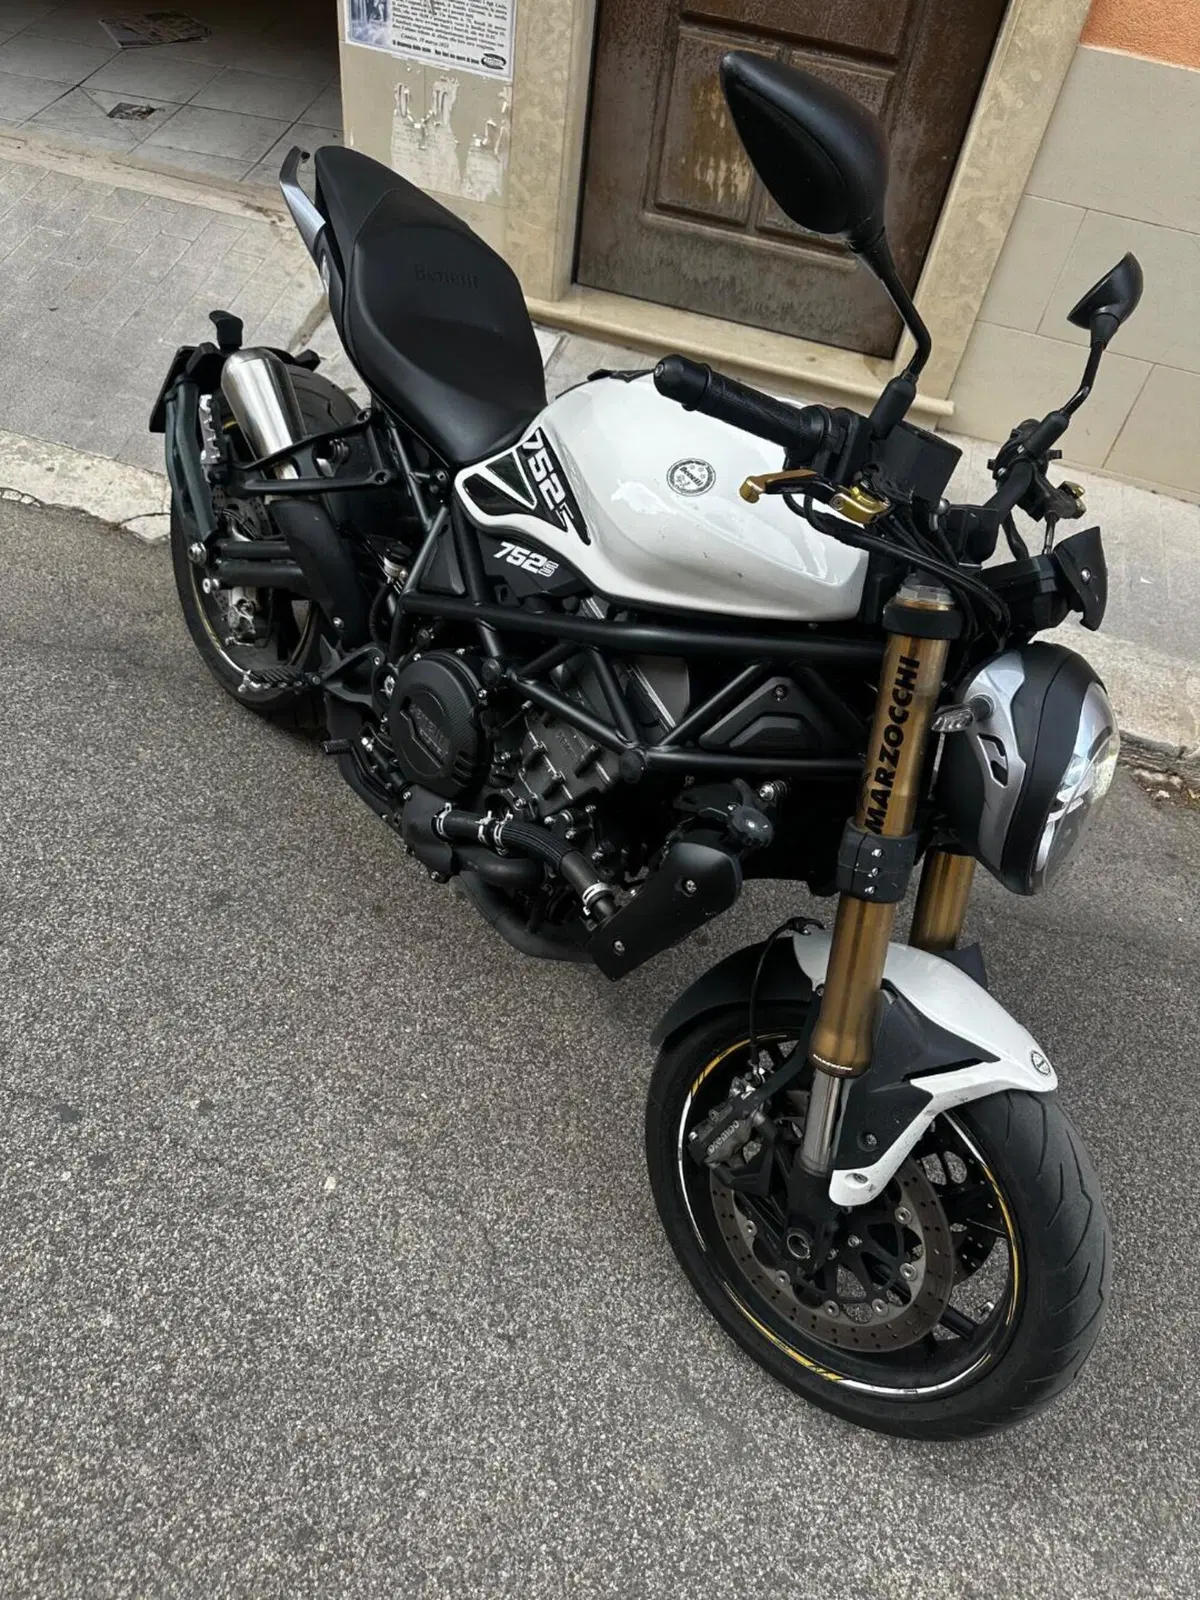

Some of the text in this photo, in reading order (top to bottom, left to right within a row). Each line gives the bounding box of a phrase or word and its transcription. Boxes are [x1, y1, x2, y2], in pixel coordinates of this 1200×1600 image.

[680, 467, 704, 486] Benelli
[493, 541, 559, 577] 752S
[864, 655, 920, 835] MARZOCCHI
[707, 1120, 740, 1154] brembo
